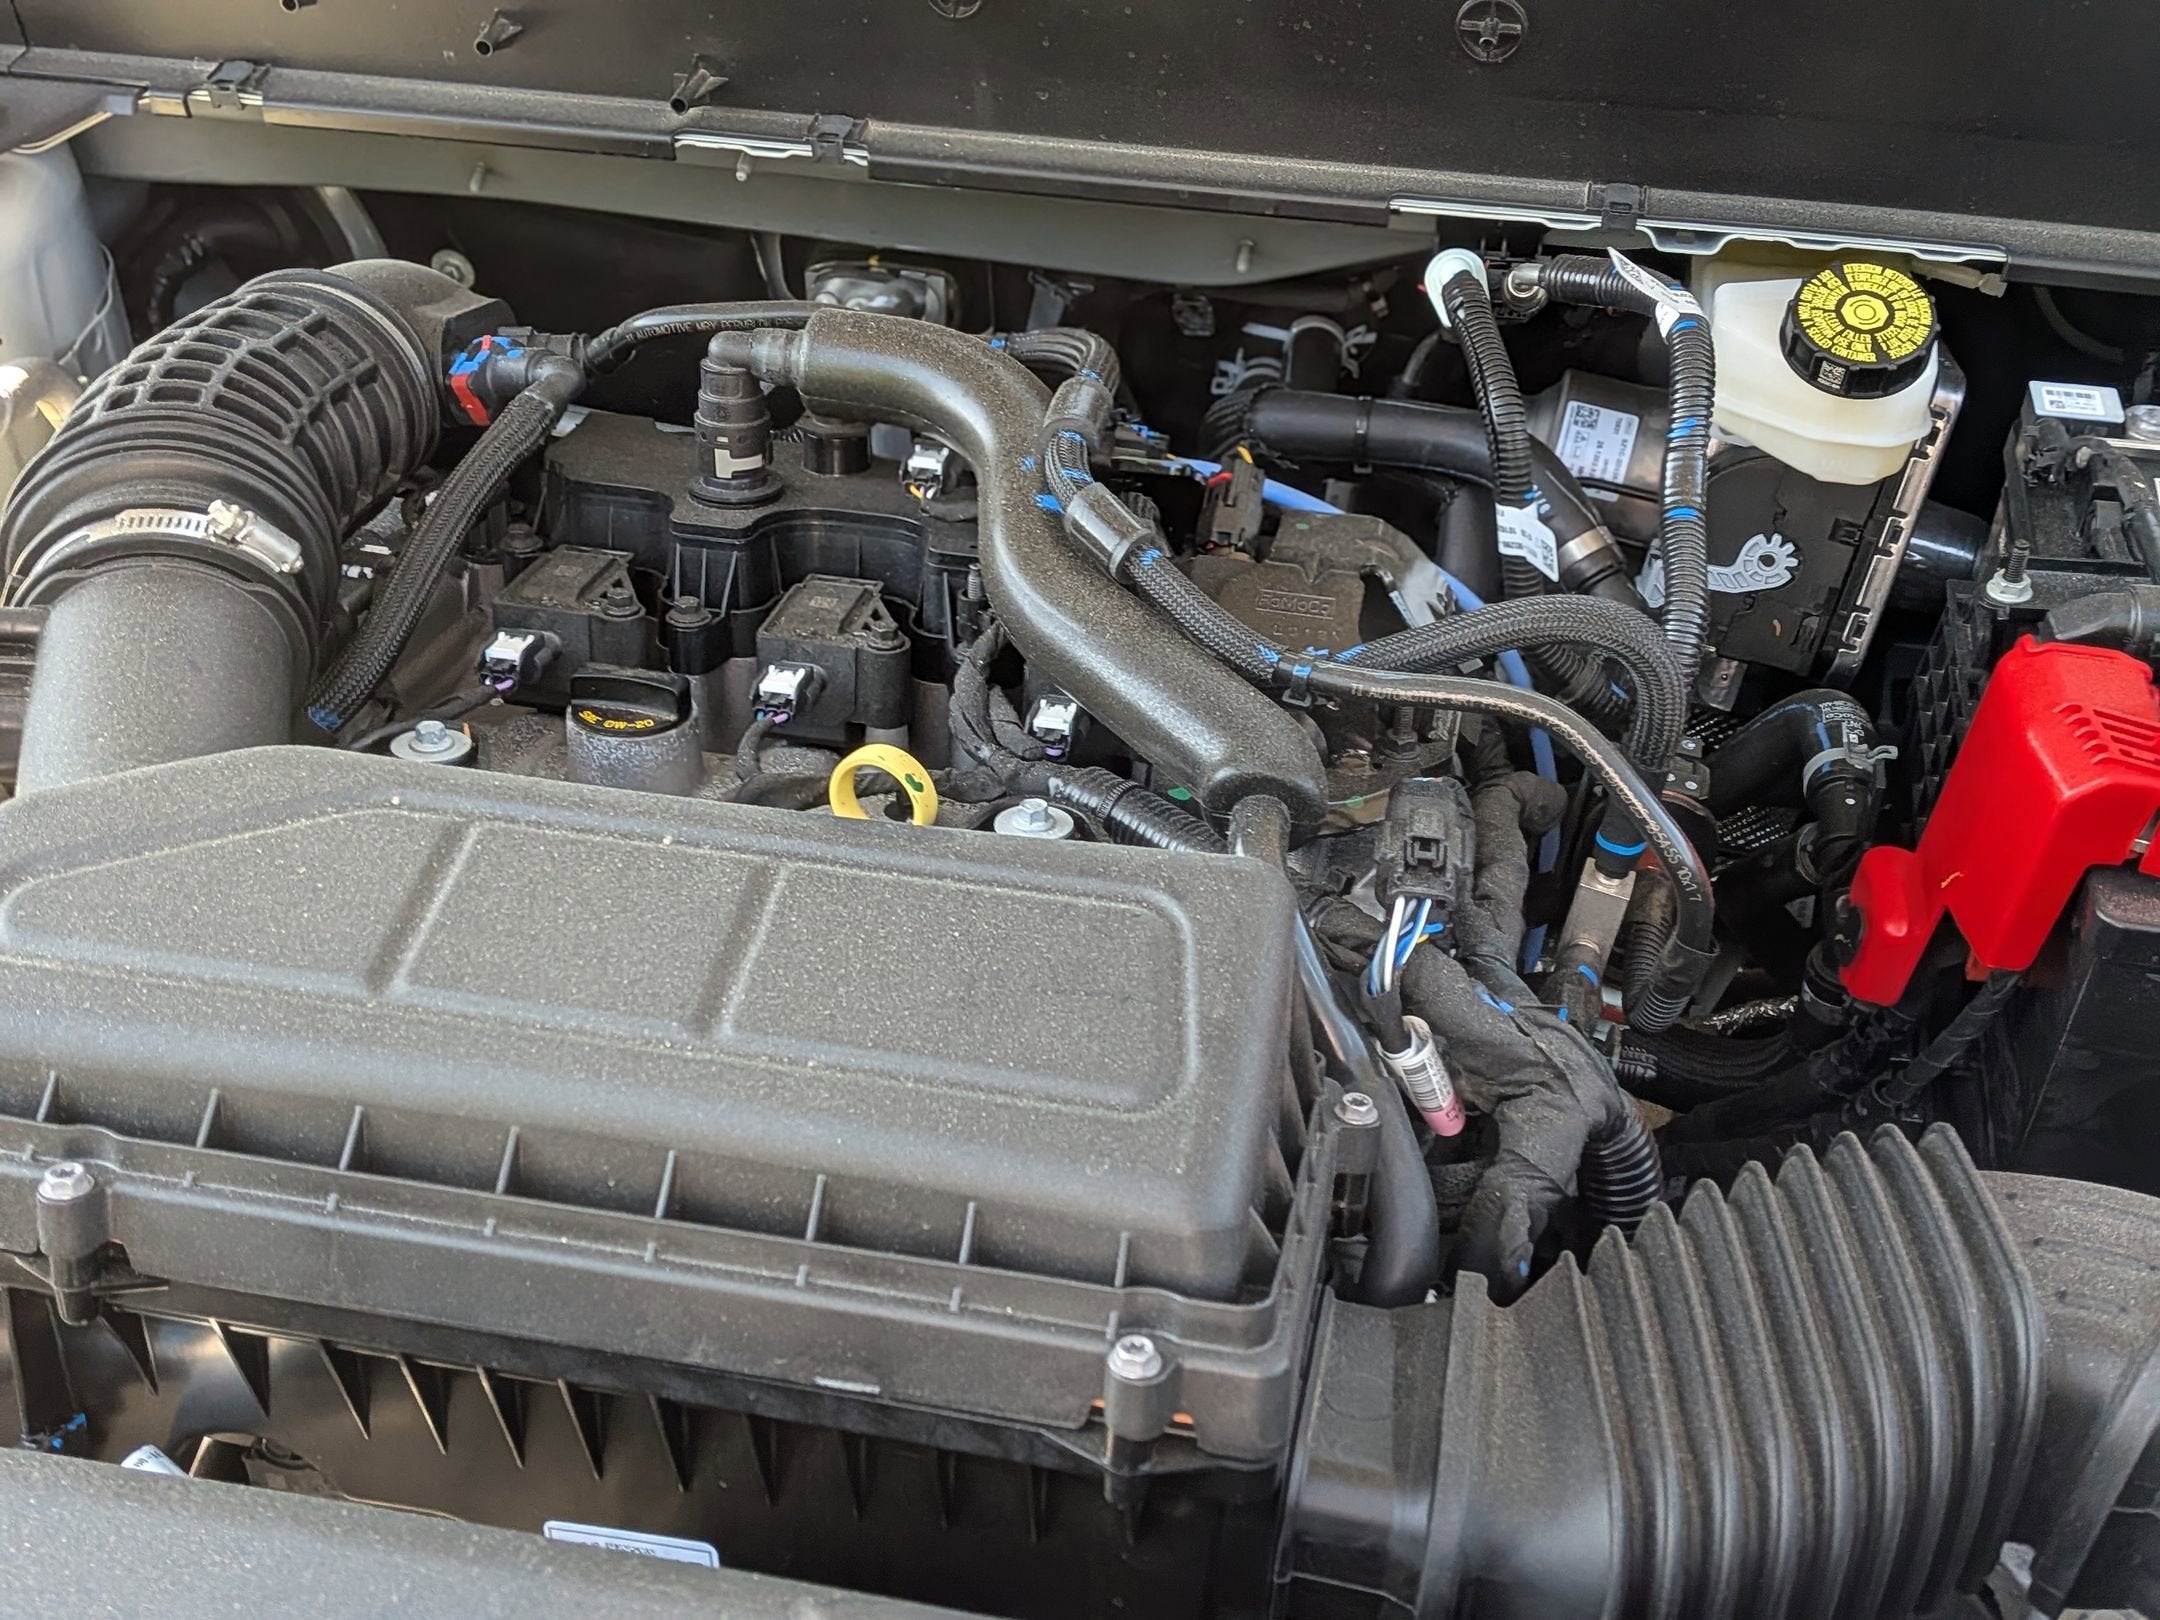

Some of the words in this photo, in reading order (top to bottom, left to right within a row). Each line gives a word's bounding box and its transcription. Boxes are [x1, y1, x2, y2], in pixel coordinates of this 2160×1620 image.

[634, 320, 692, 343] AUTOMOTIVE
[1841, 329, 1872, 343] FILLER
[1806, 327, 1833, 348] SEALED
[1831, 345, 1877, 362] CONTAINER
[1833, 335, 1851, 348] USE
[1259, 593, 1330, 616] FoMoCo
[603, 719, 655, 730] 0W-20
